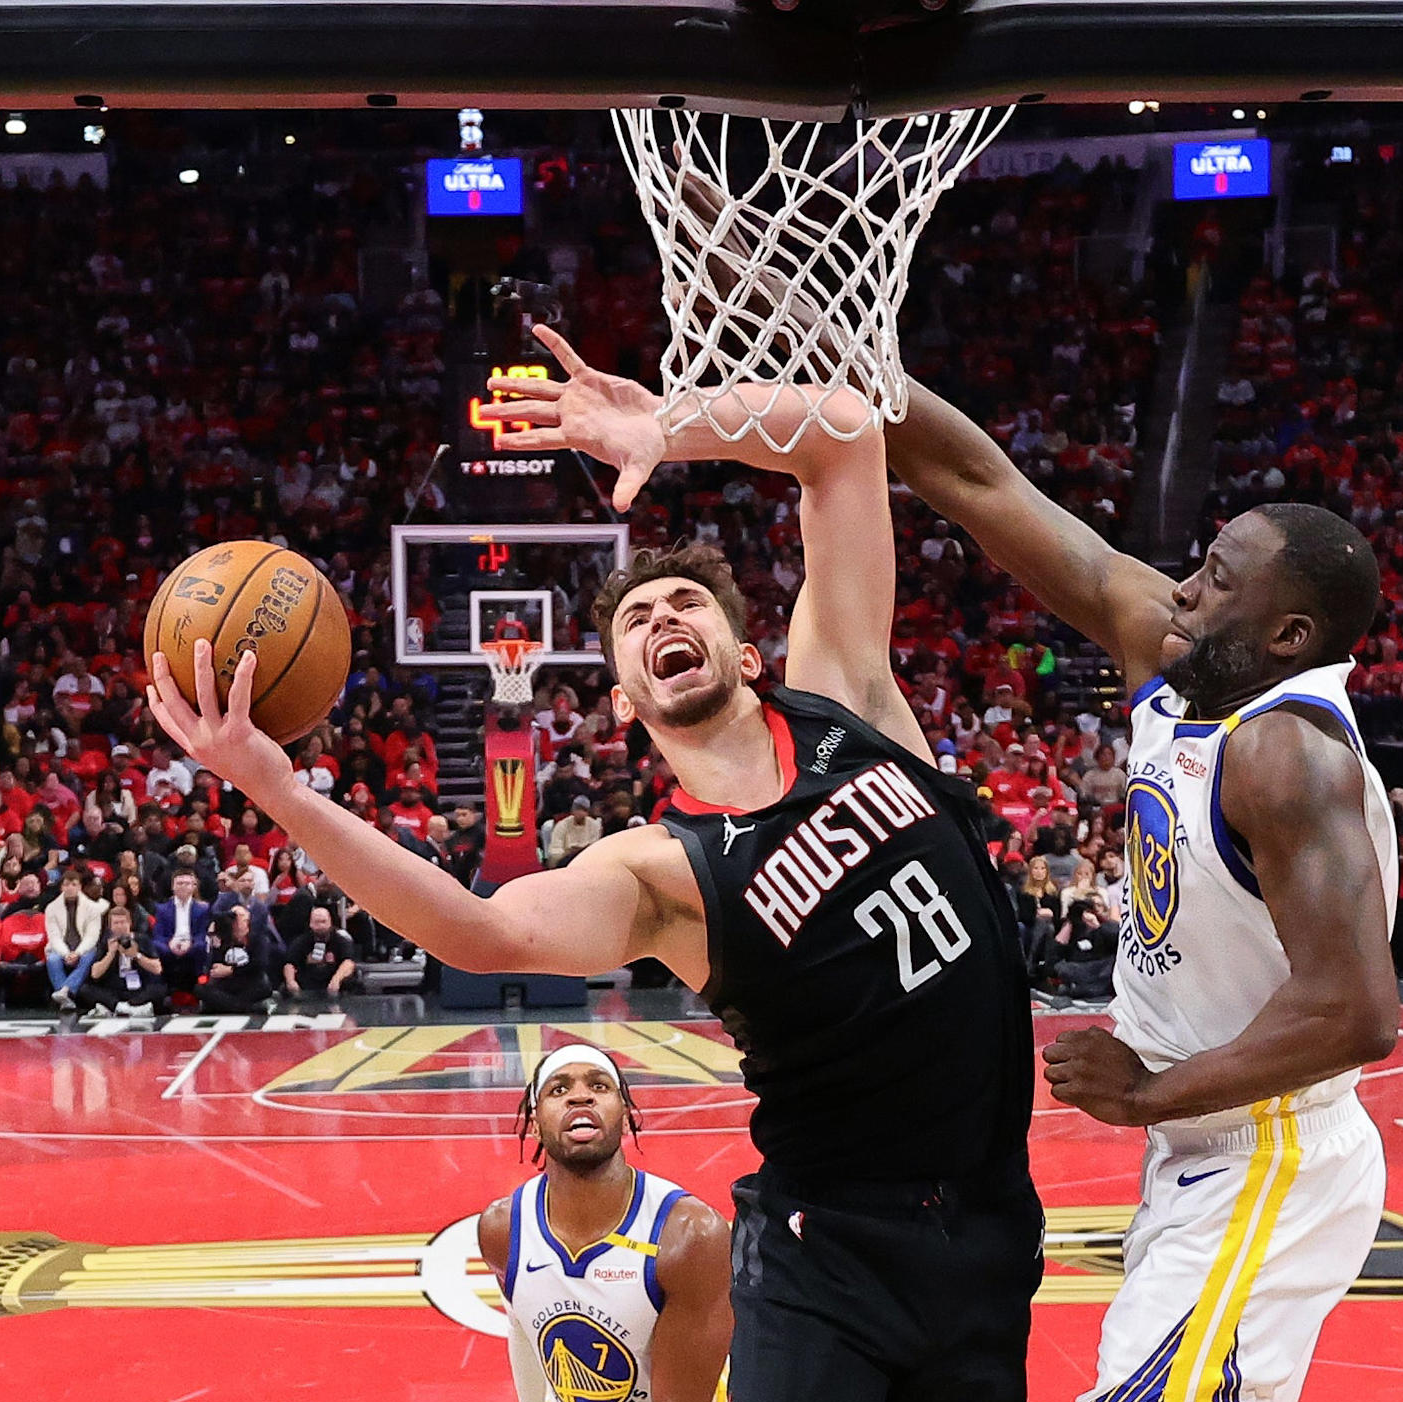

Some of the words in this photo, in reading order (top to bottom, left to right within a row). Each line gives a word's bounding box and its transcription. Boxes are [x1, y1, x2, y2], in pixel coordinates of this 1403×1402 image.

[1190, 155, 1253, 175] ULTRA
[444, 174, 506, 192] ULTRA
[486, 459, 555, 475] TISSOT
[744, 761, 938, 949] HOUSTON
[1145, 833, 1168, 890] 23
[853, 860, 972, 992] 28
[594, 1268, 638, 1282] Rakuten
[531, 1299, 582, 1331] GOLDEN
[587, 1307, 631, 1341] STATE
[592, 1342, 609, 1372] 7
